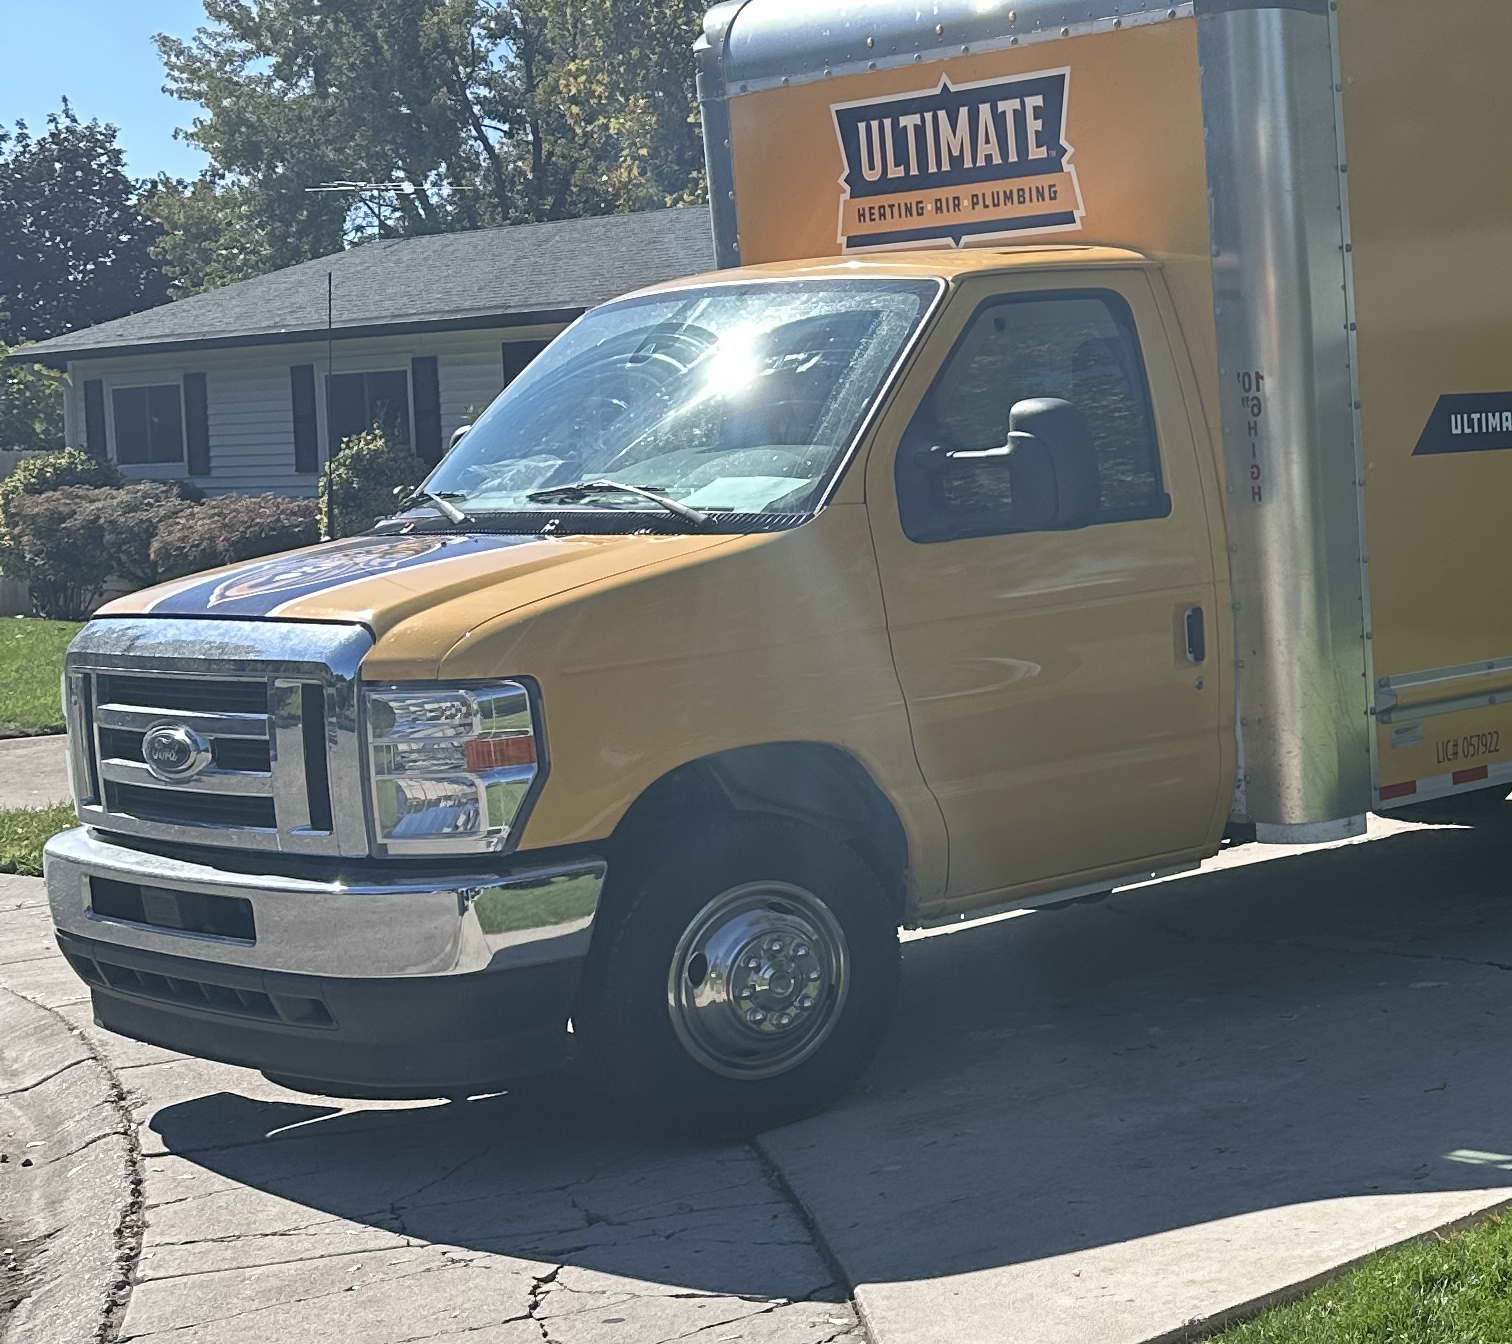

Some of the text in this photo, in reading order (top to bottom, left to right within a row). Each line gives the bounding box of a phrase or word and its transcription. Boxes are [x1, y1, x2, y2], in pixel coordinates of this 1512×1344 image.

[857, 94, 1048, 182] ULTIMATE
[857, 183, 1058, 223] HEATING AIR PLUMBING
